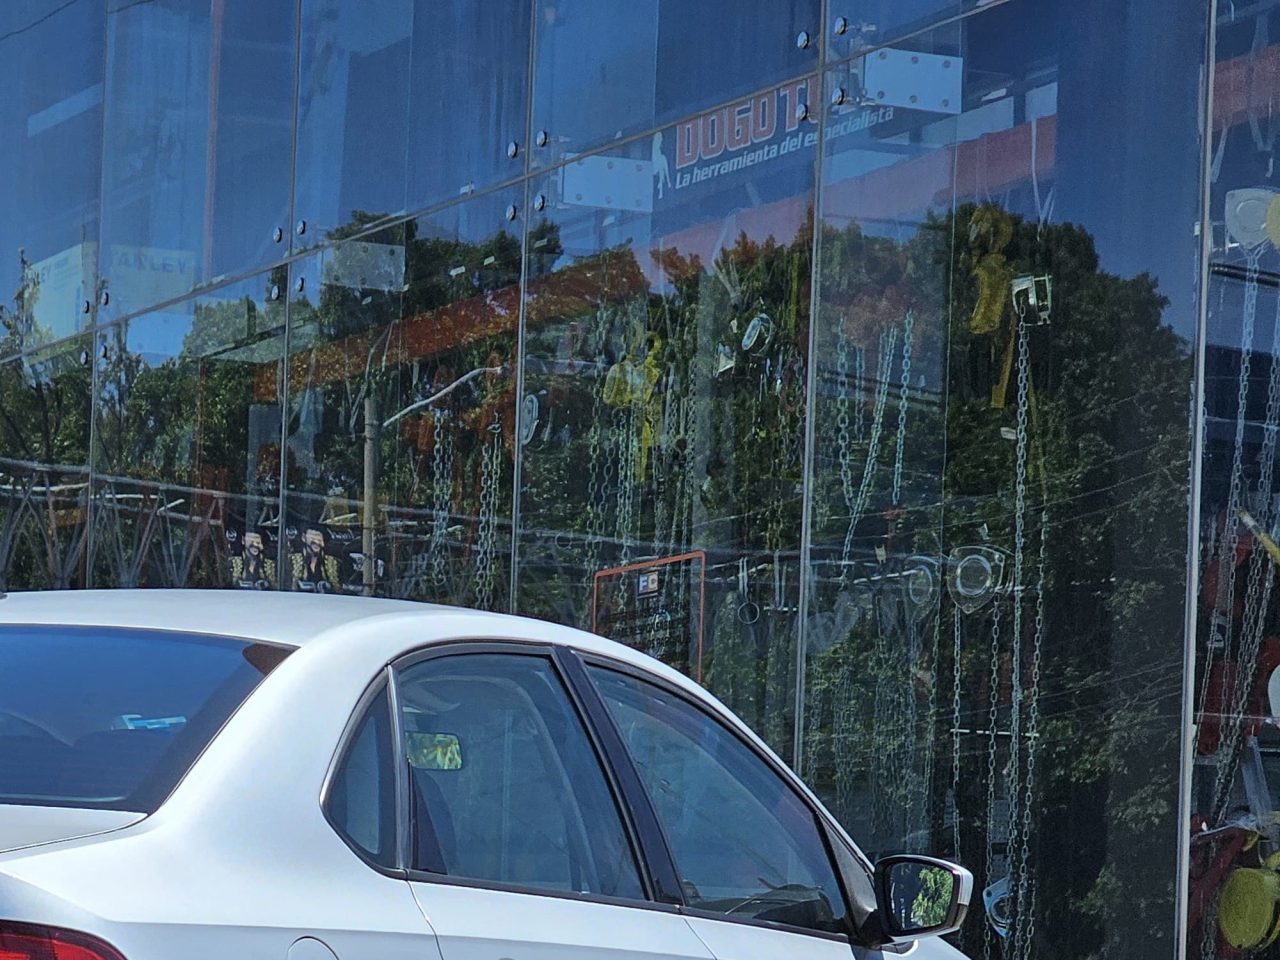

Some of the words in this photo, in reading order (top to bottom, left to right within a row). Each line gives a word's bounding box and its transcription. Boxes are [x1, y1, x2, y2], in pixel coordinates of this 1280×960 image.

[676, 172, 690, 190] La
[692, 143, 778, 184] herramienta
[780, 131, 802, 155] del
